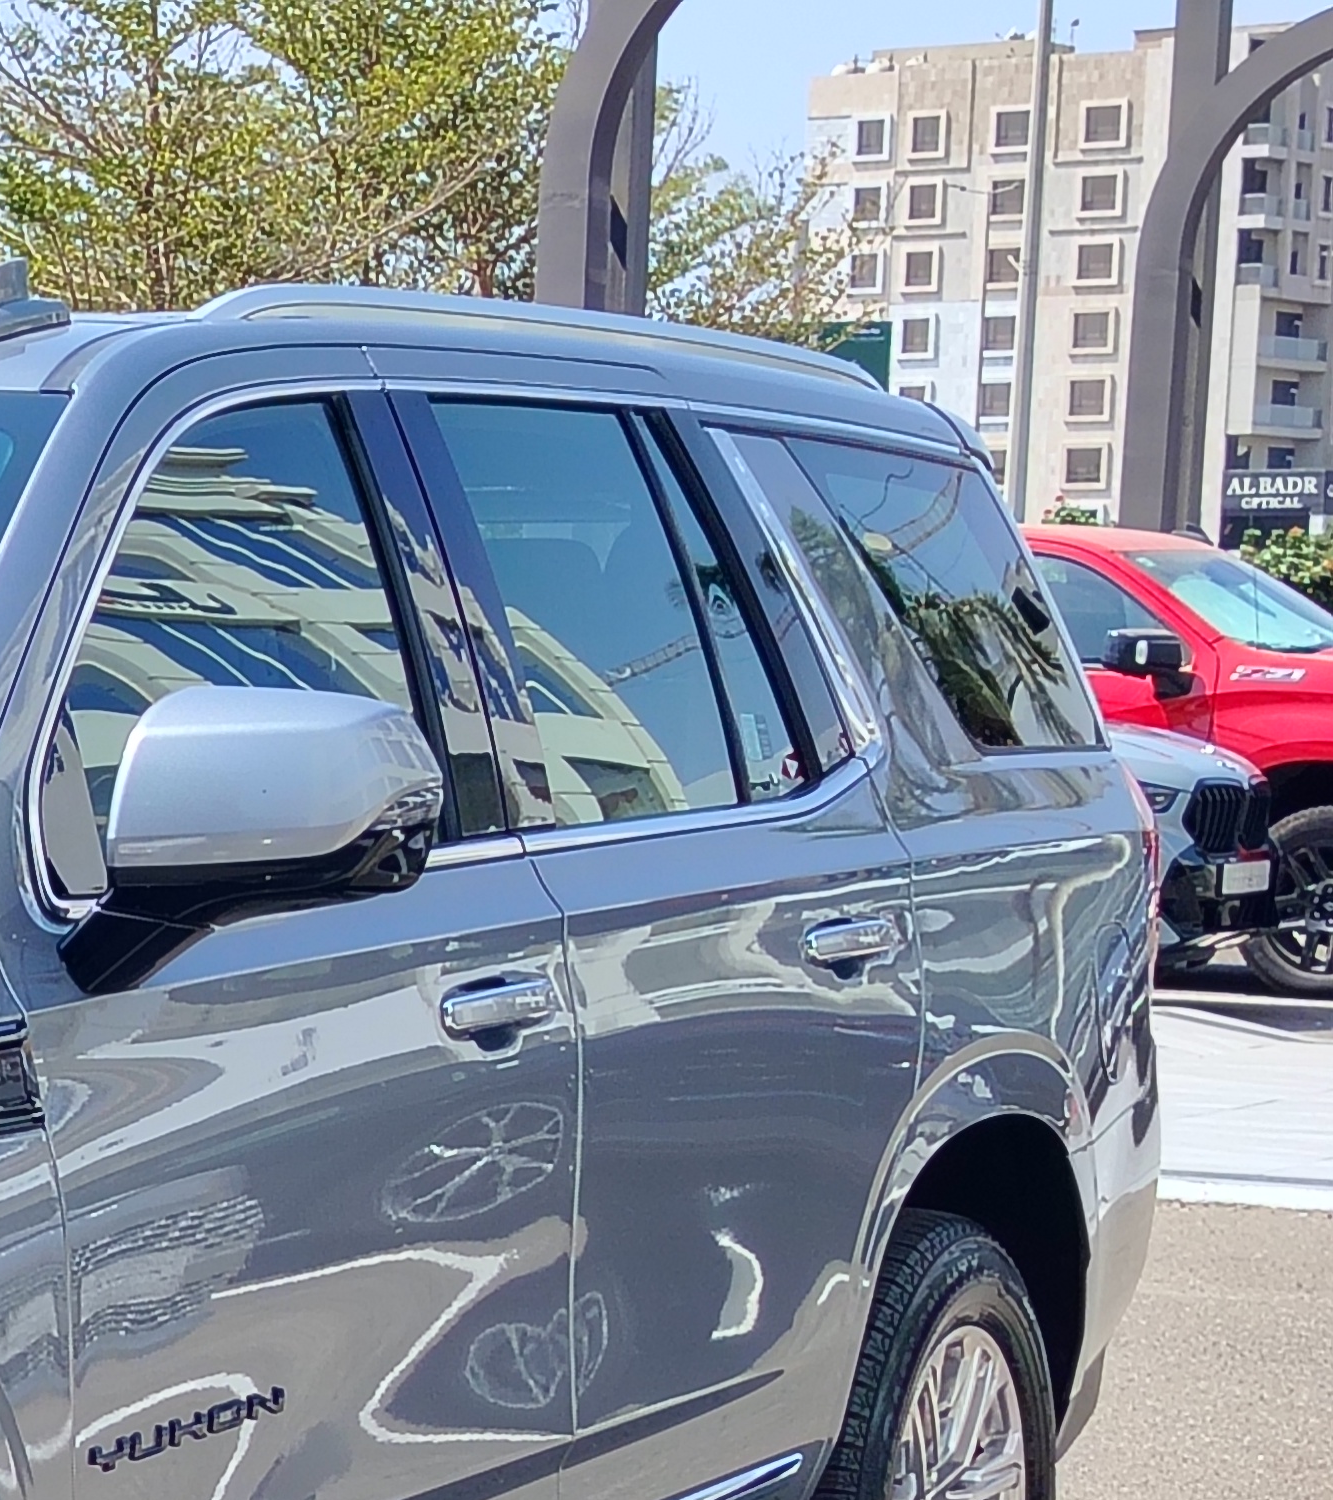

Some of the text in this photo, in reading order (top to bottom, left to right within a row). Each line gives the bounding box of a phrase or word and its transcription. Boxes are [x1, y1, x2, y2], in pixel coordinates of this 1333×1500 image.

[1226, 477, 1256, 495] AL
[1259, 476, 1318, 494] BADR
[88, 1386, 285, 1472] YUKON
